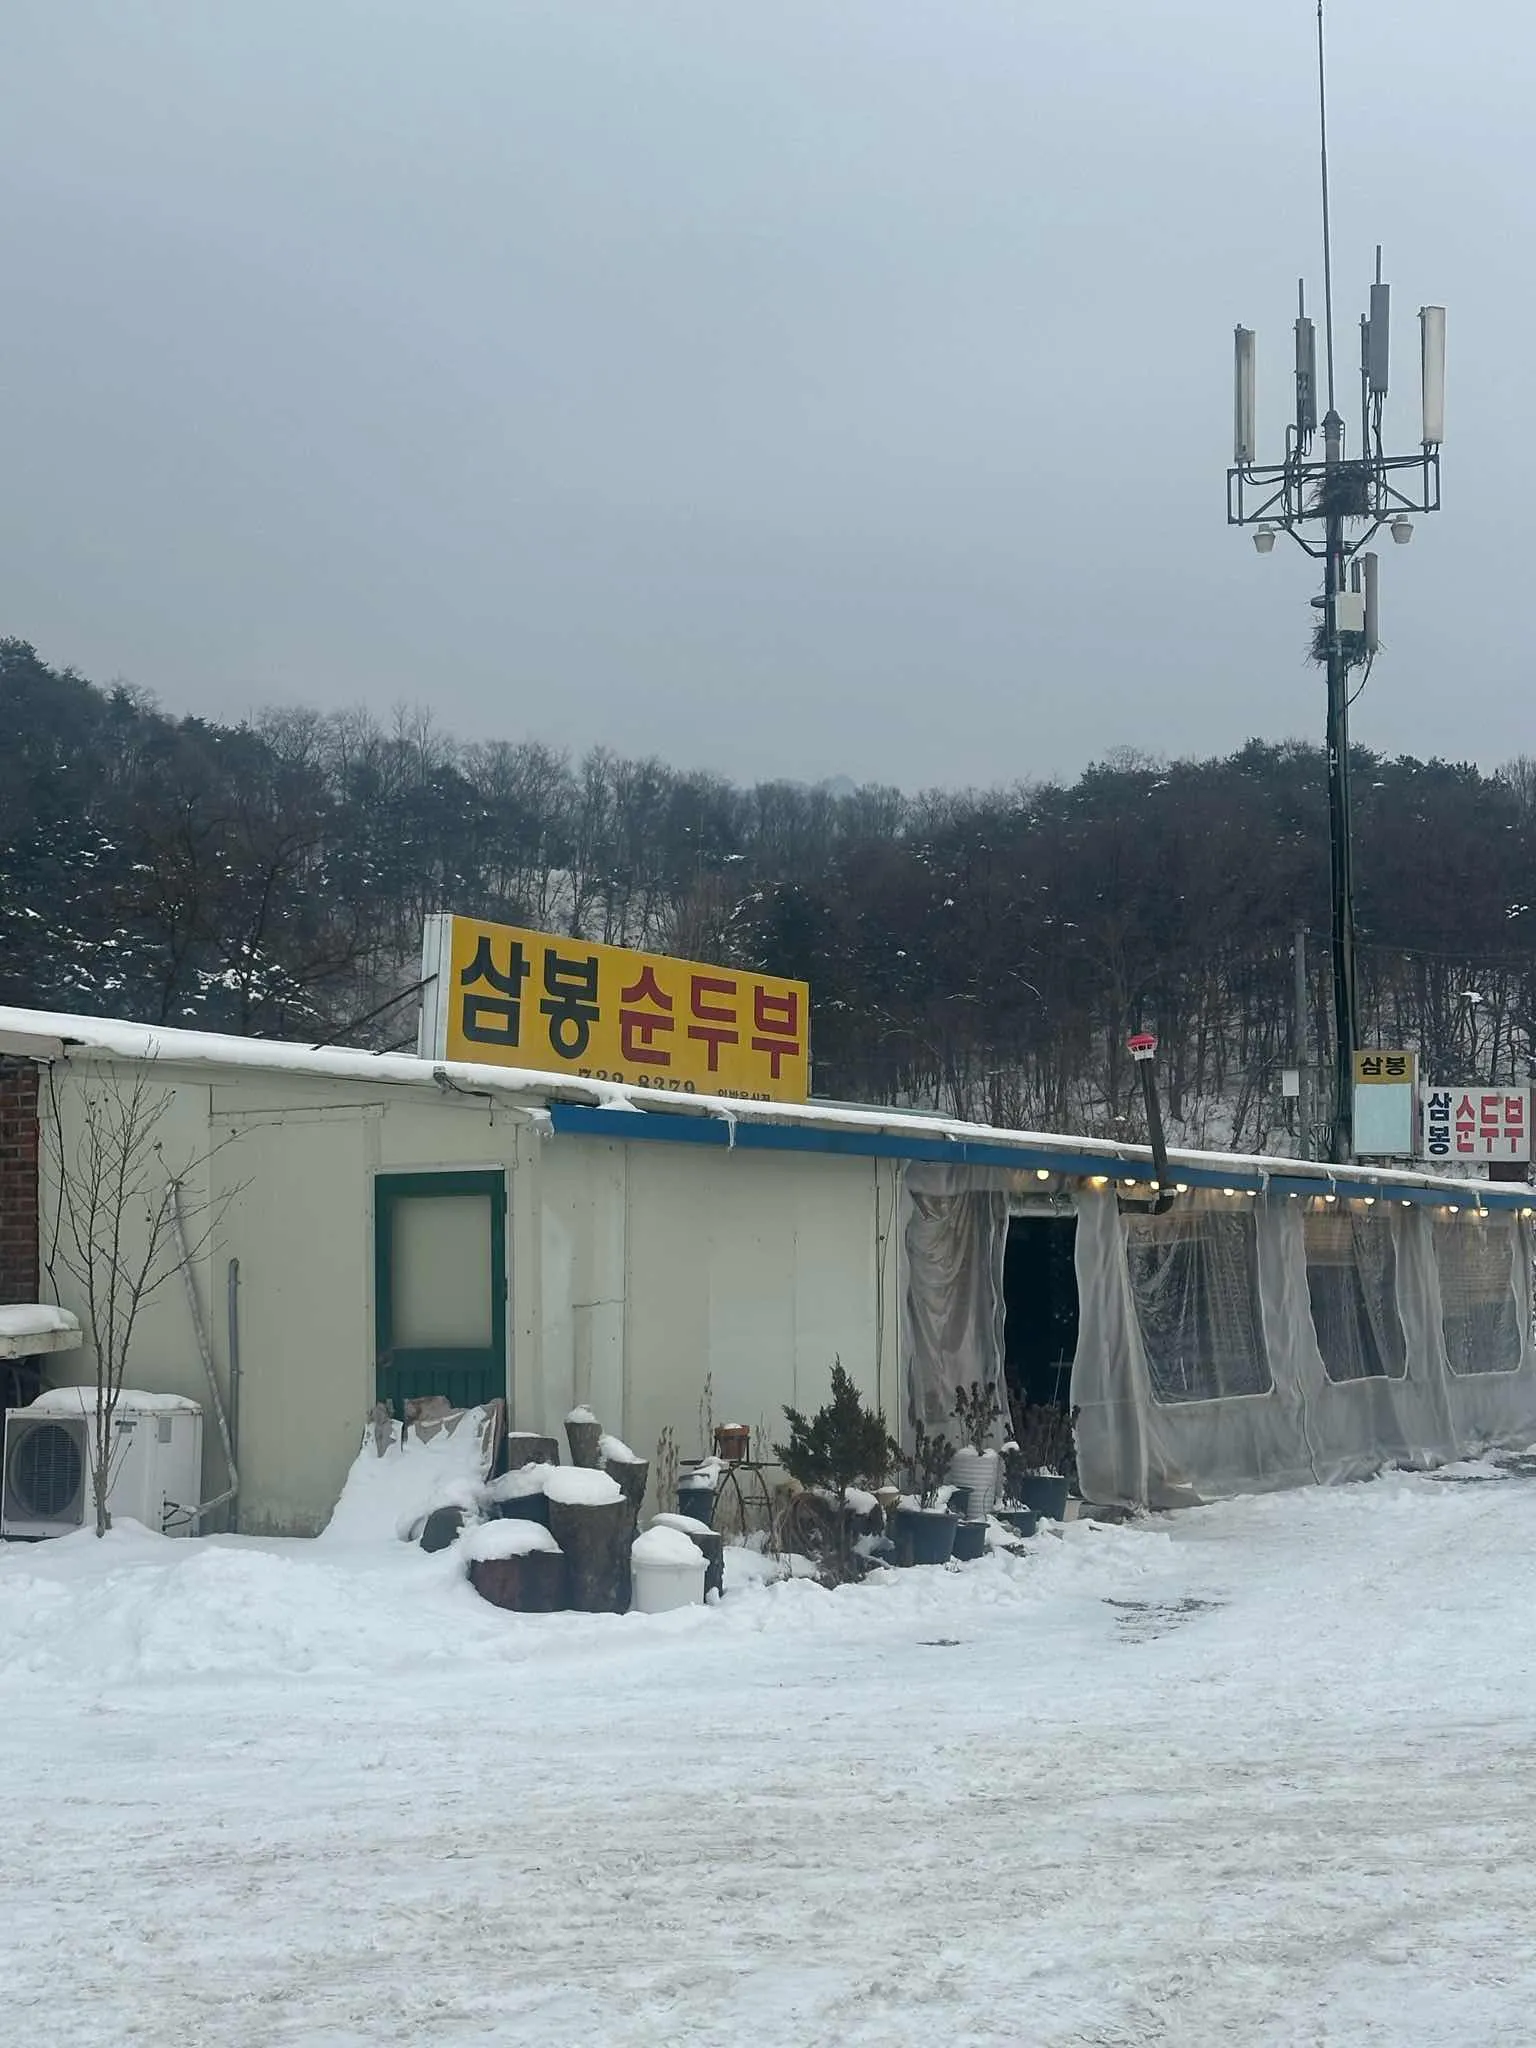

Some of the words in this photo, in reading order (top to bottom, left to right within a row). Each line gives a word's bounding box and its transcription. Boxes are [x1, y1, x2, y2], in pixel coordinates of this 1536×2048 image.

[461, 935, 600, 1060] 삼봉
[619, 965, 800, 1080] 순두부
[1360, 1056, 1406, 1076] 삼봉
[1428, 1092, 1452, 1155] 삼봉
[1455, 1094, 1524, 1154] 순두부
